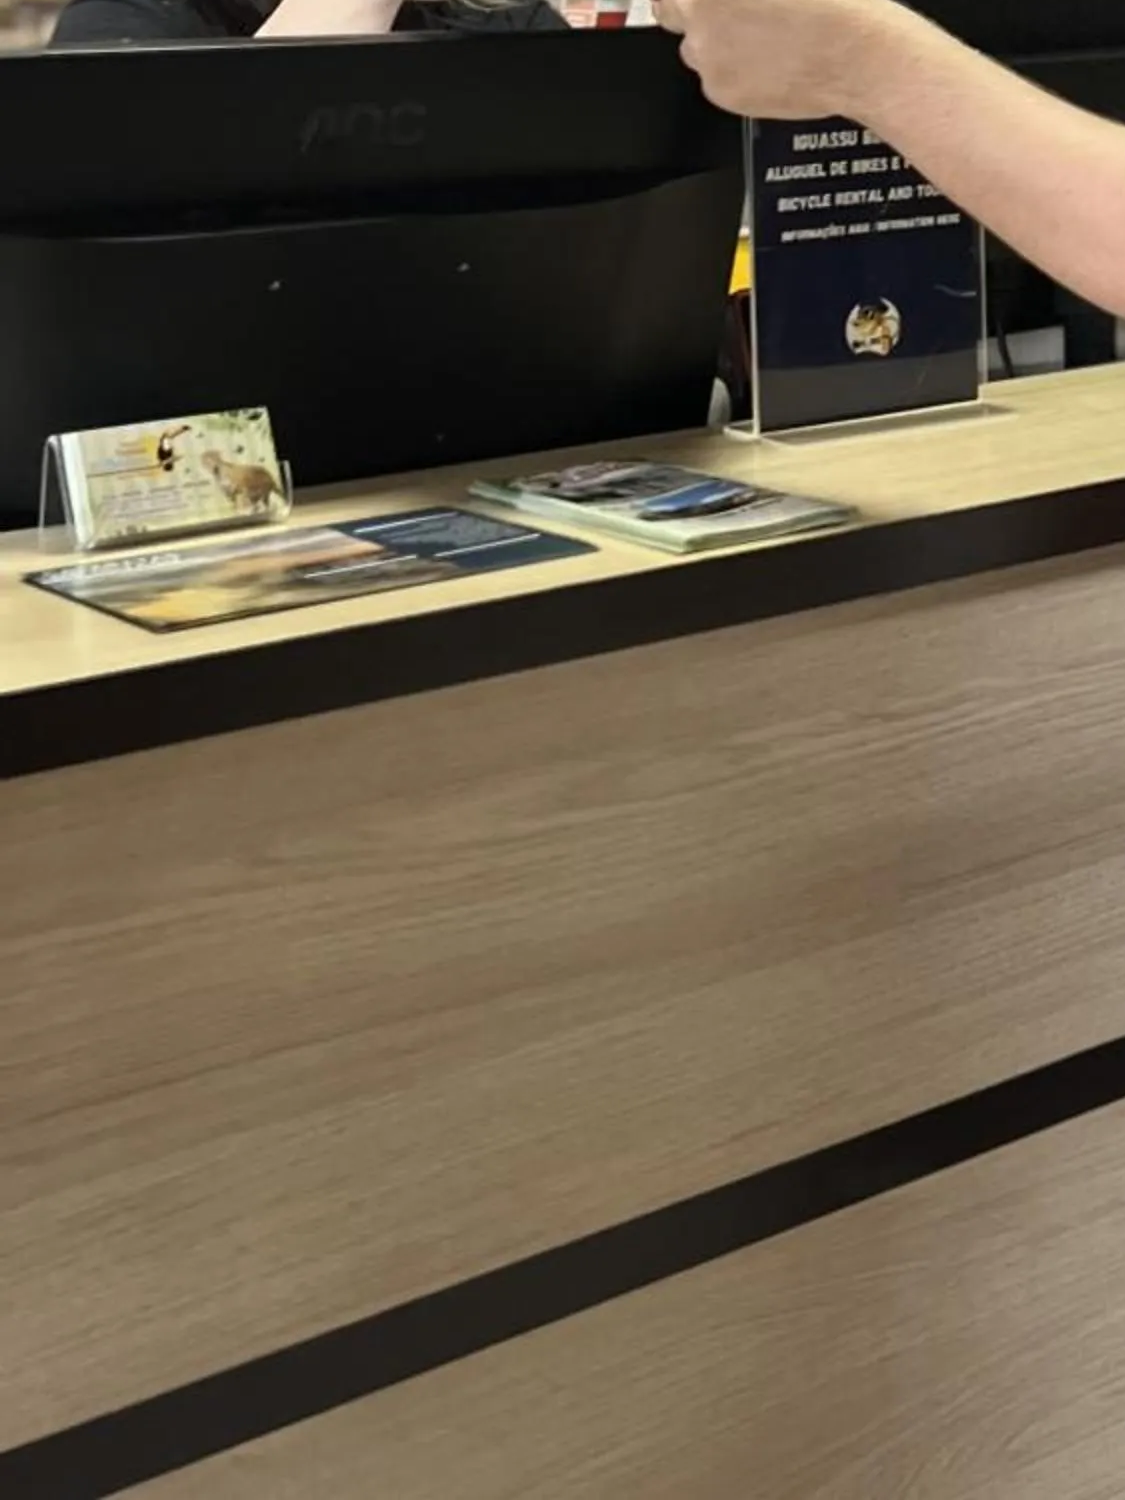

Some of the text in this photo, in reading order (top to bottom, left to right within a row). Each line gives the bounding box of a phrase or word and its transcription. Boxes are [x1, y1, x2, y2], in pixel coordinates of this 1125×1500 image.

[792, 130, 859, 151] IGUASSU
[765, 162, 827, 182] ALUGUEL
[830, 161, 848, 176] DE
[852, 157, 888, 174] BIKES
[777, 193, 832, 212] BICYCLE
[835, 188, 884, 206] RENTAL
[888, 185, 913, 200] AND
